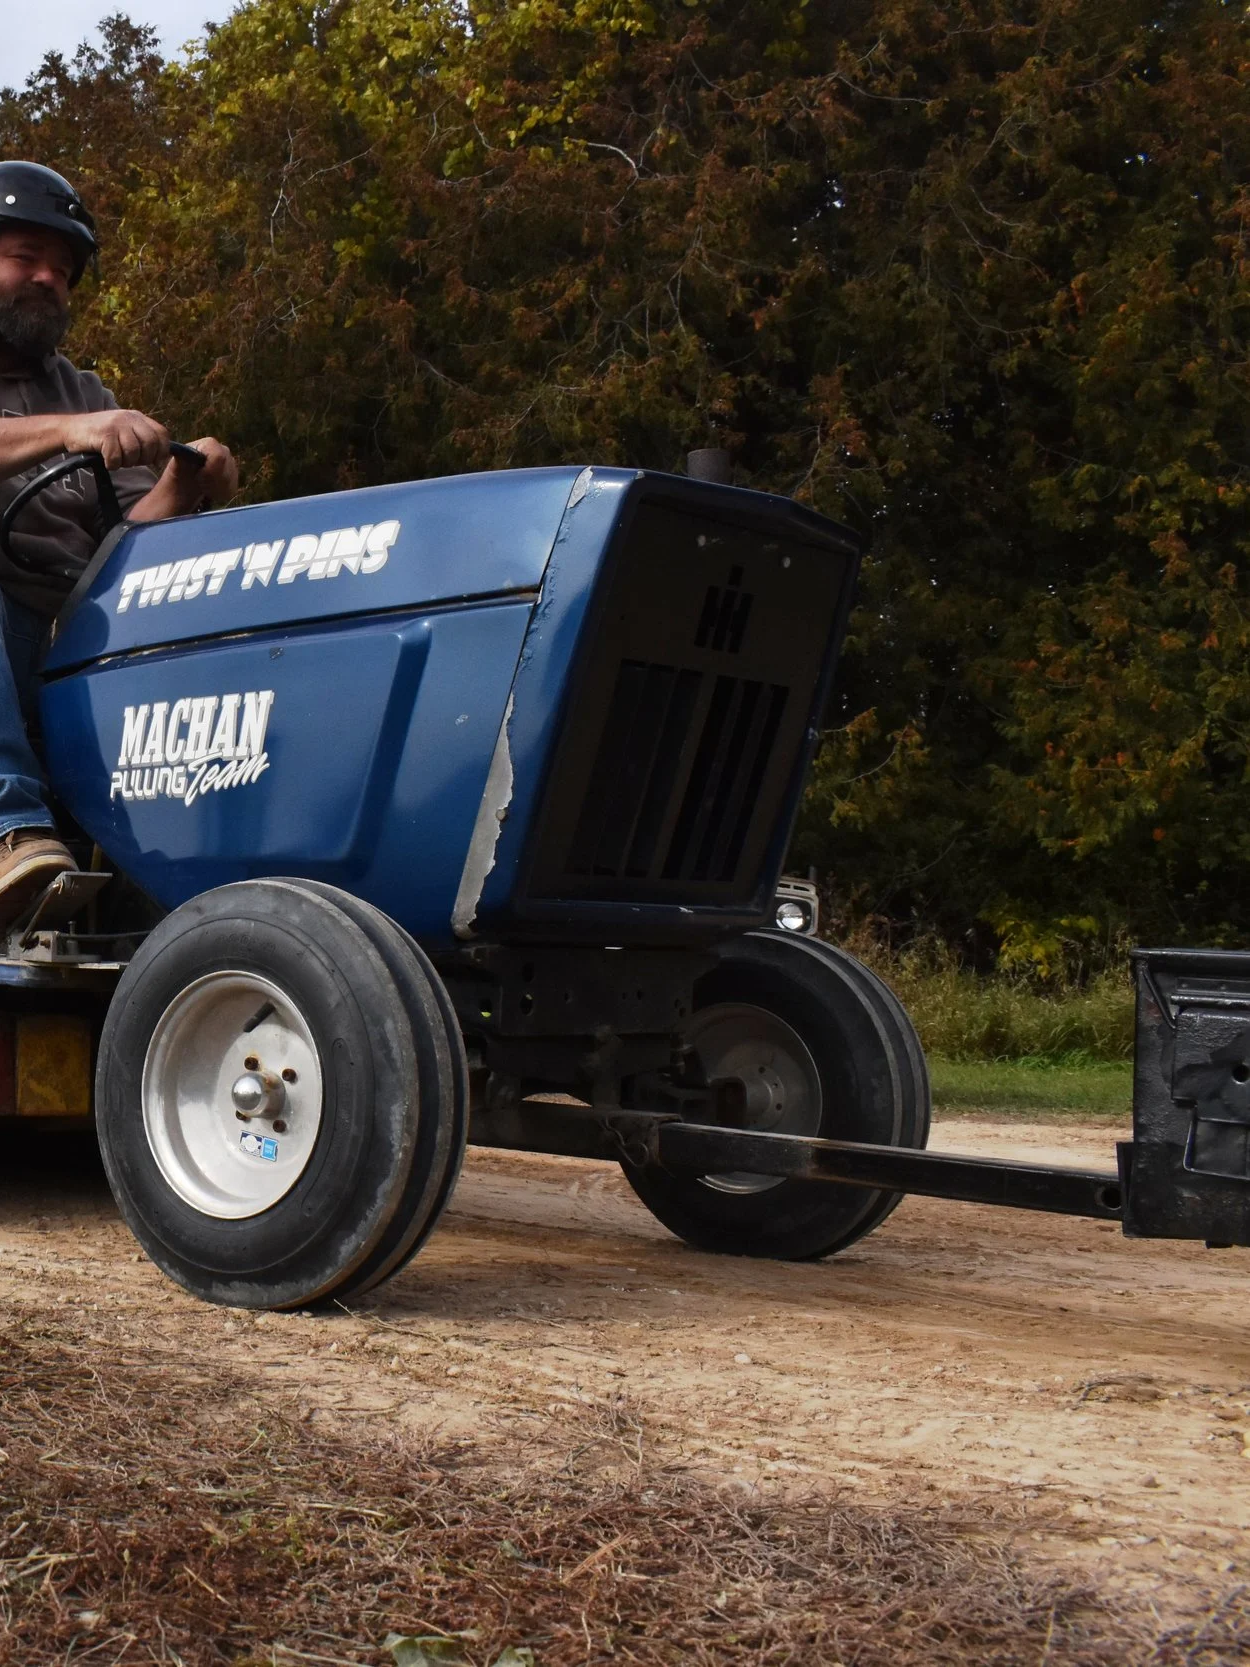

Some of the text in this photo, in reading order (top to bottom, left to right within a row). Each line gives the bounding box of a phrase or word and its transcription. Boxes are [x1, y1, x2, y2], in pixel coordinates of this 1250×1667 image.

[116, 547, 243, 614] TWIST
[276, 520, 401, 584] PINS
[118, 690, 275, 768] MACHAN
[110, 751, 270, 807] PULLING Team
